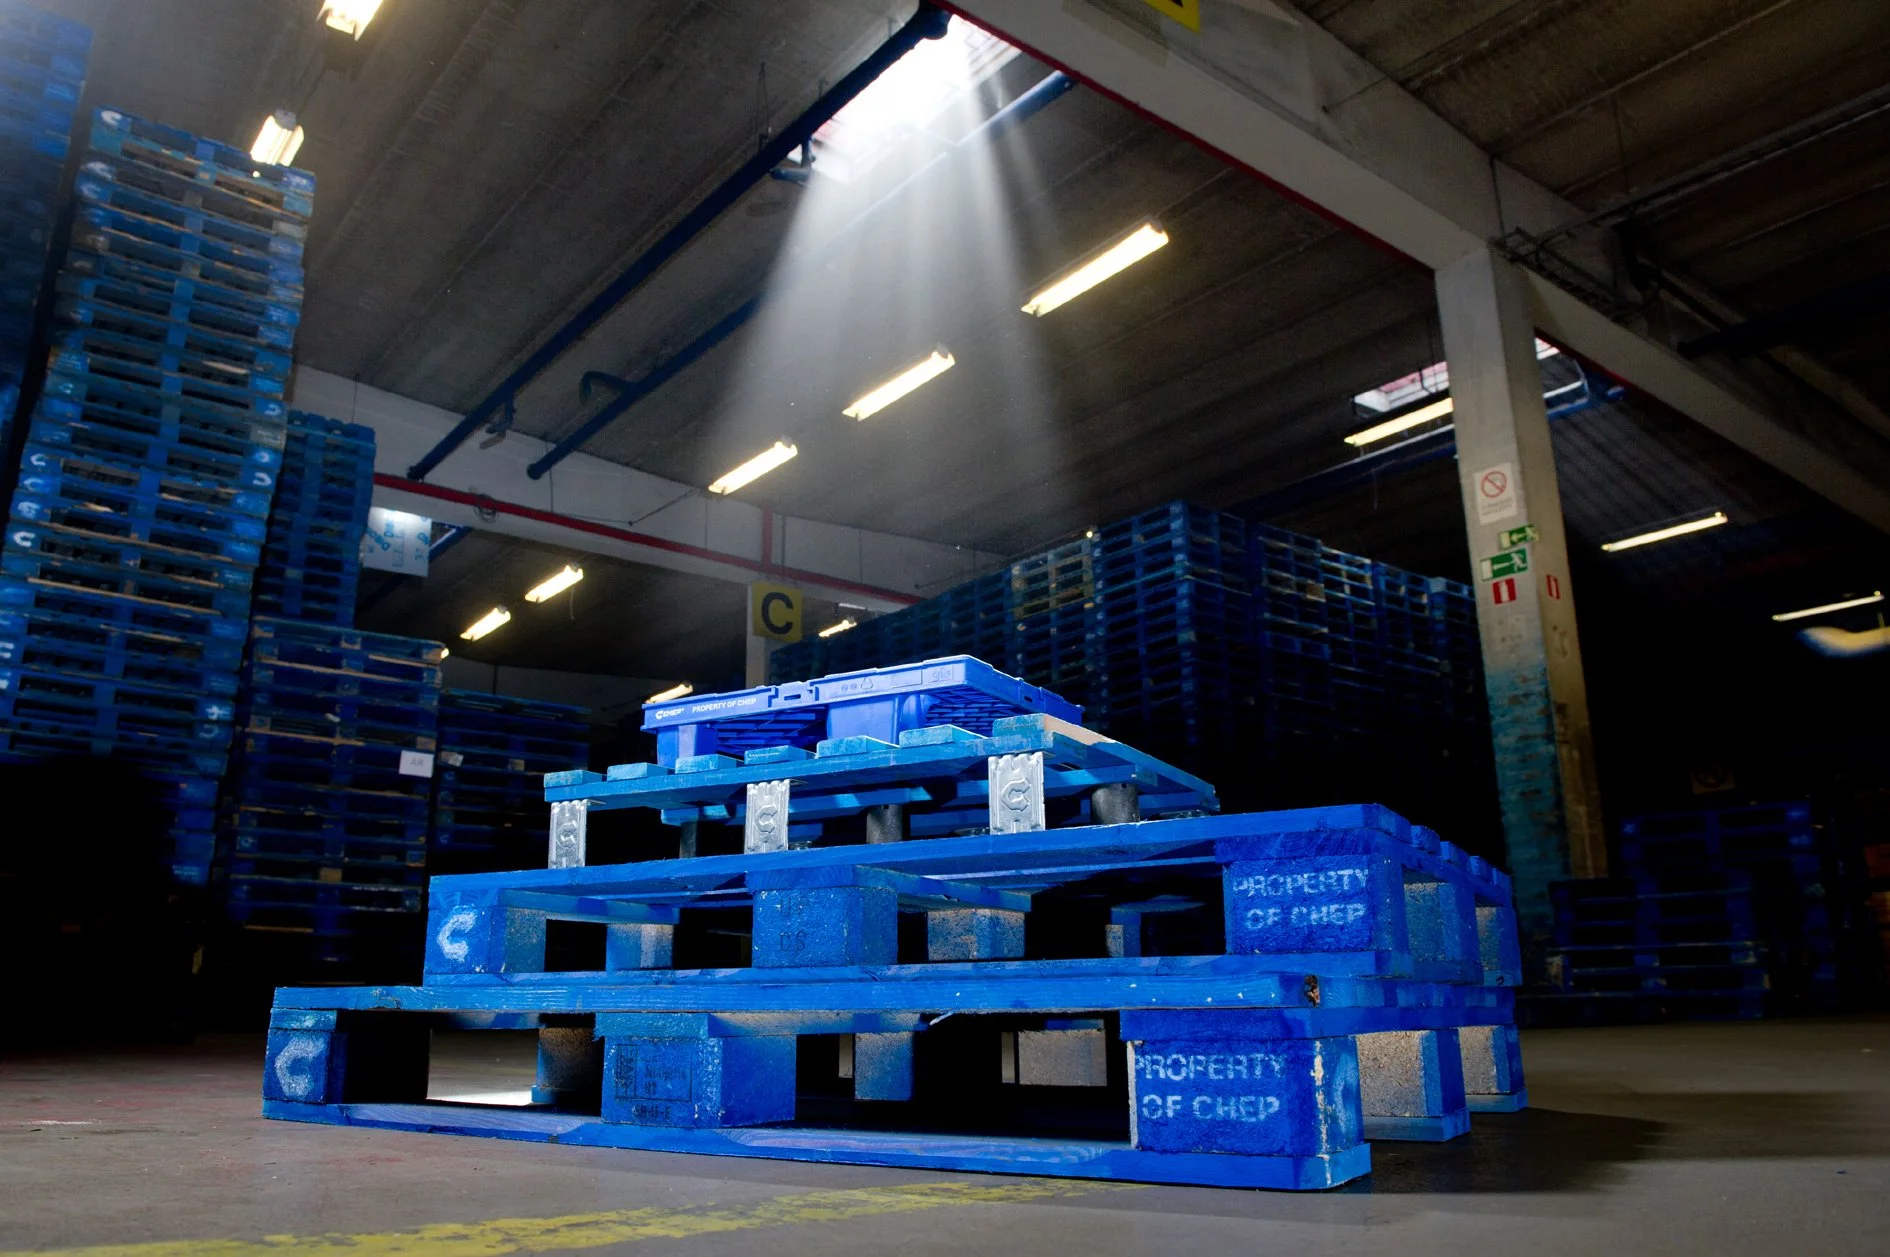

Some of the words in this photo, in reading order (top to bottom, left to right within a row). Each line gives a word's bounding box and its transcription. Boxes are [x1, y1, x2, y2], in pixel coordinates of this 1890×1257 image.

[762, 592, 793, 634] C
[692, 702, 726, 713] PROPERTY
[727, 700, 737, 708] OF
[1232, 869, 1369, 897] PROPERTY
[1246, 907, 1281, 929] OF
[436, 906, 478, 963] C
[274, 1038, 325, 1098] C
[1142, 1094, 1182, 1120] OF
[1192, 1095, 1280, 1123] CHEP
